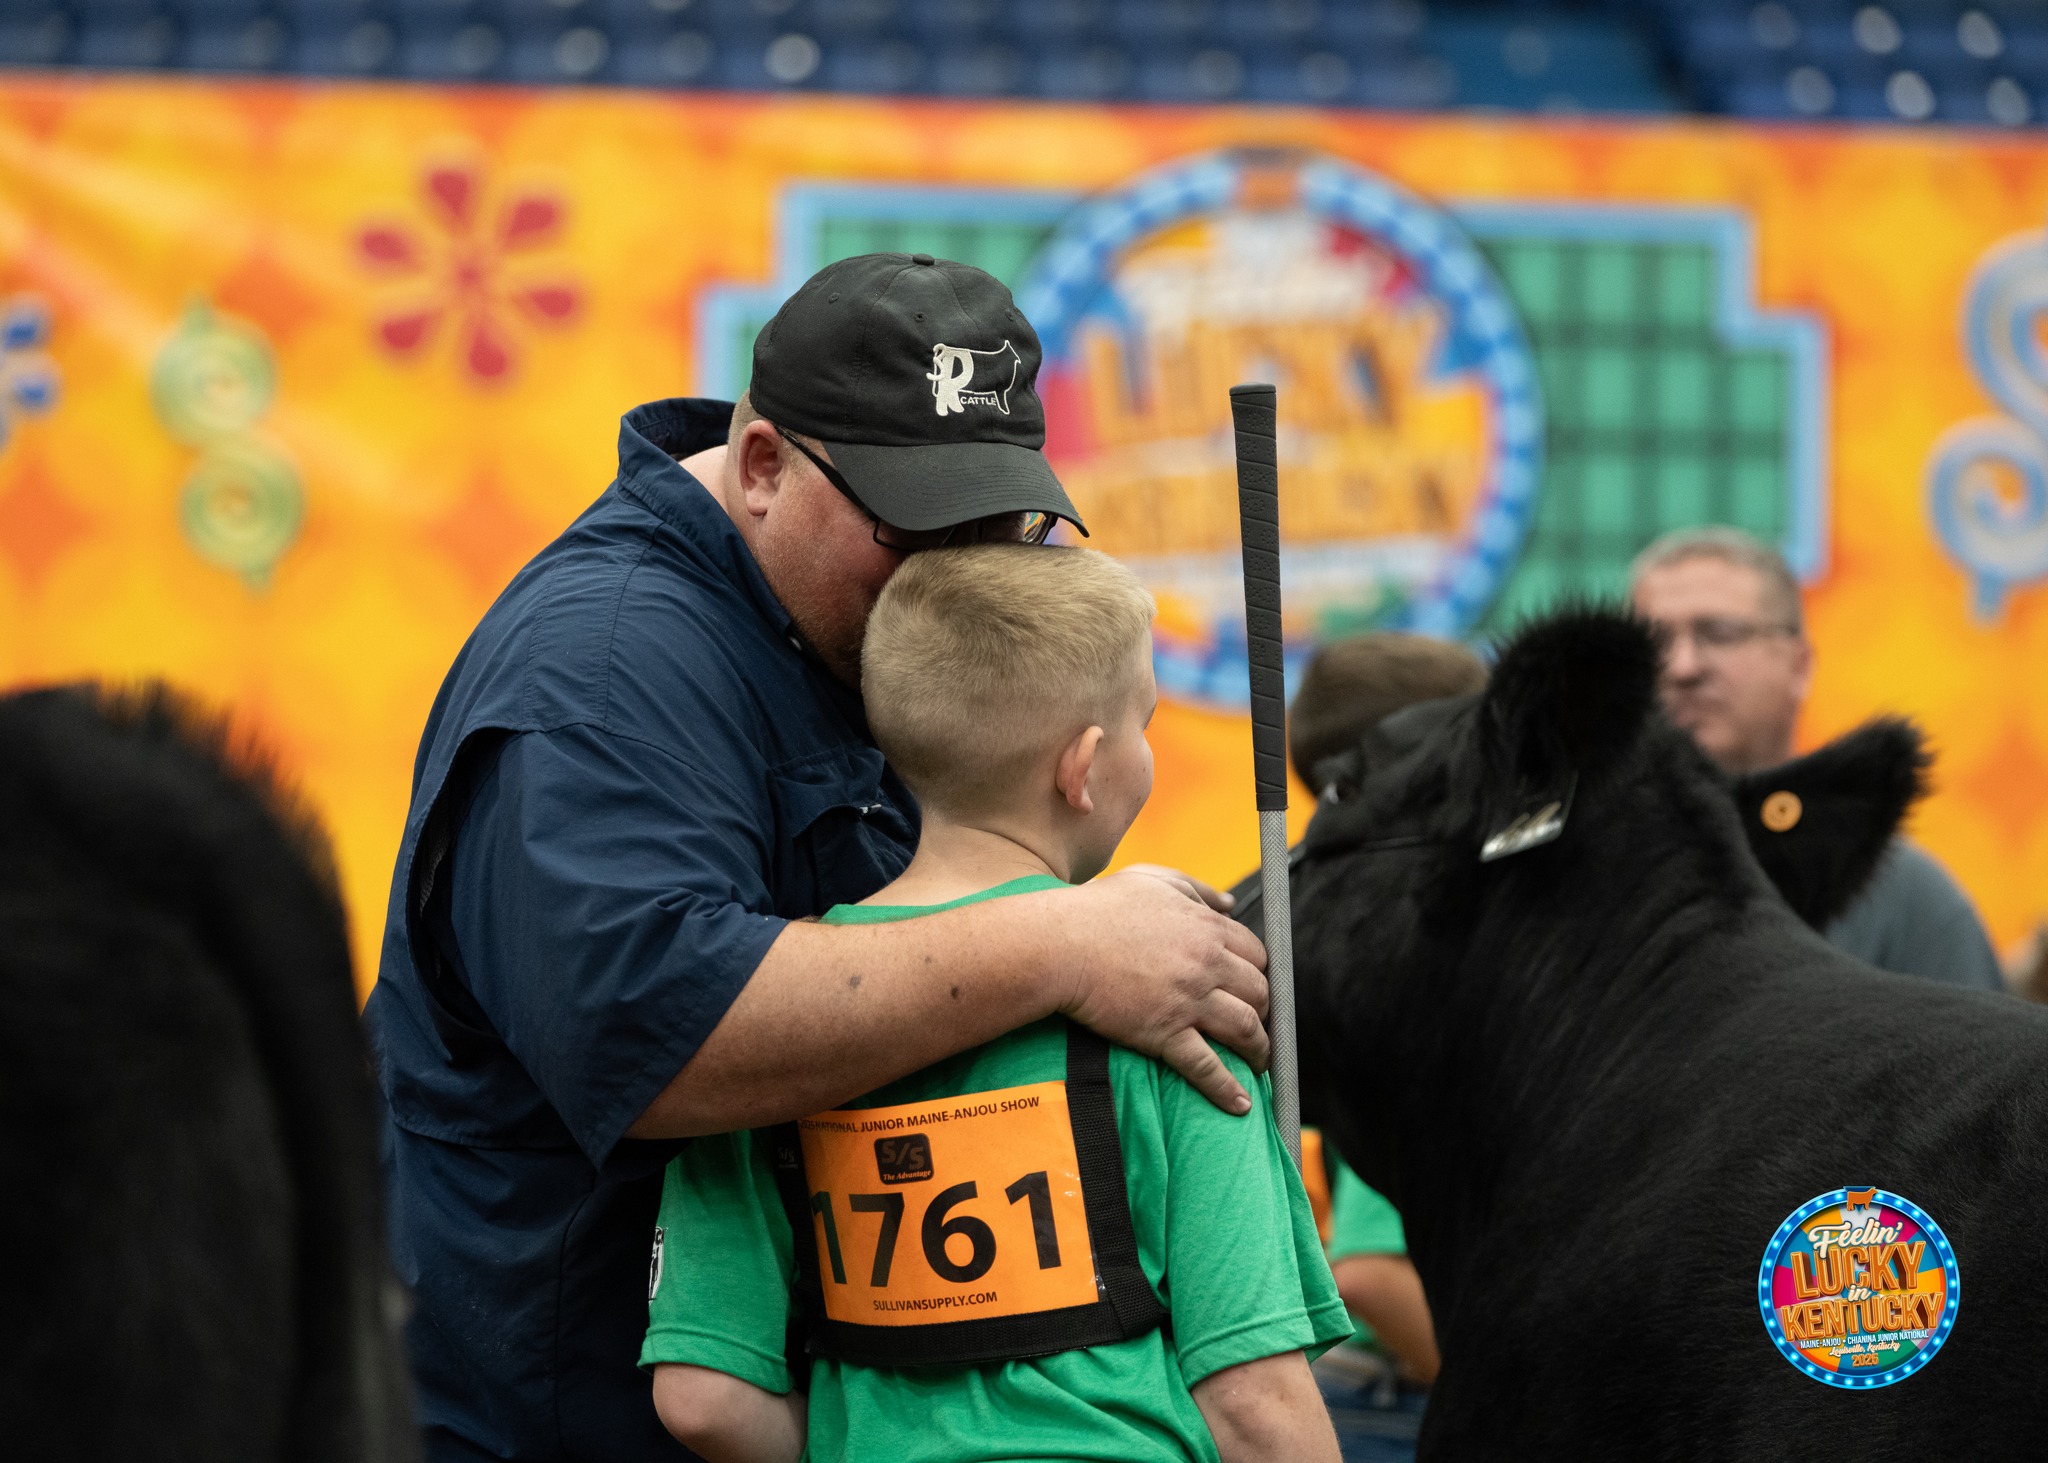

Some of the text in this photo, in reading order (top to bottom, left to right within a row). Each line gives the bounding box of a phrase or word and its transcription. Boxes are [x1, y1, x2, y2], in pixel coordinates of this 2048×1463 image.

[960, 396, 997, 406] CATTLE
[815, 1120, 859, 1133] NATIONAL
[860, 1117, 905, 1133] JUNIOR
[907, 1103, 998, 1127] MAINE-ANJOU
[1000, 1096, 1040, 1112] SHOW
[883, 1169, 932, 1181] The Advantage
[810, 1170, 1062, 1287] 1761
[873, 1290, 998, 1312] SULLIVANSUPPLY.COM
